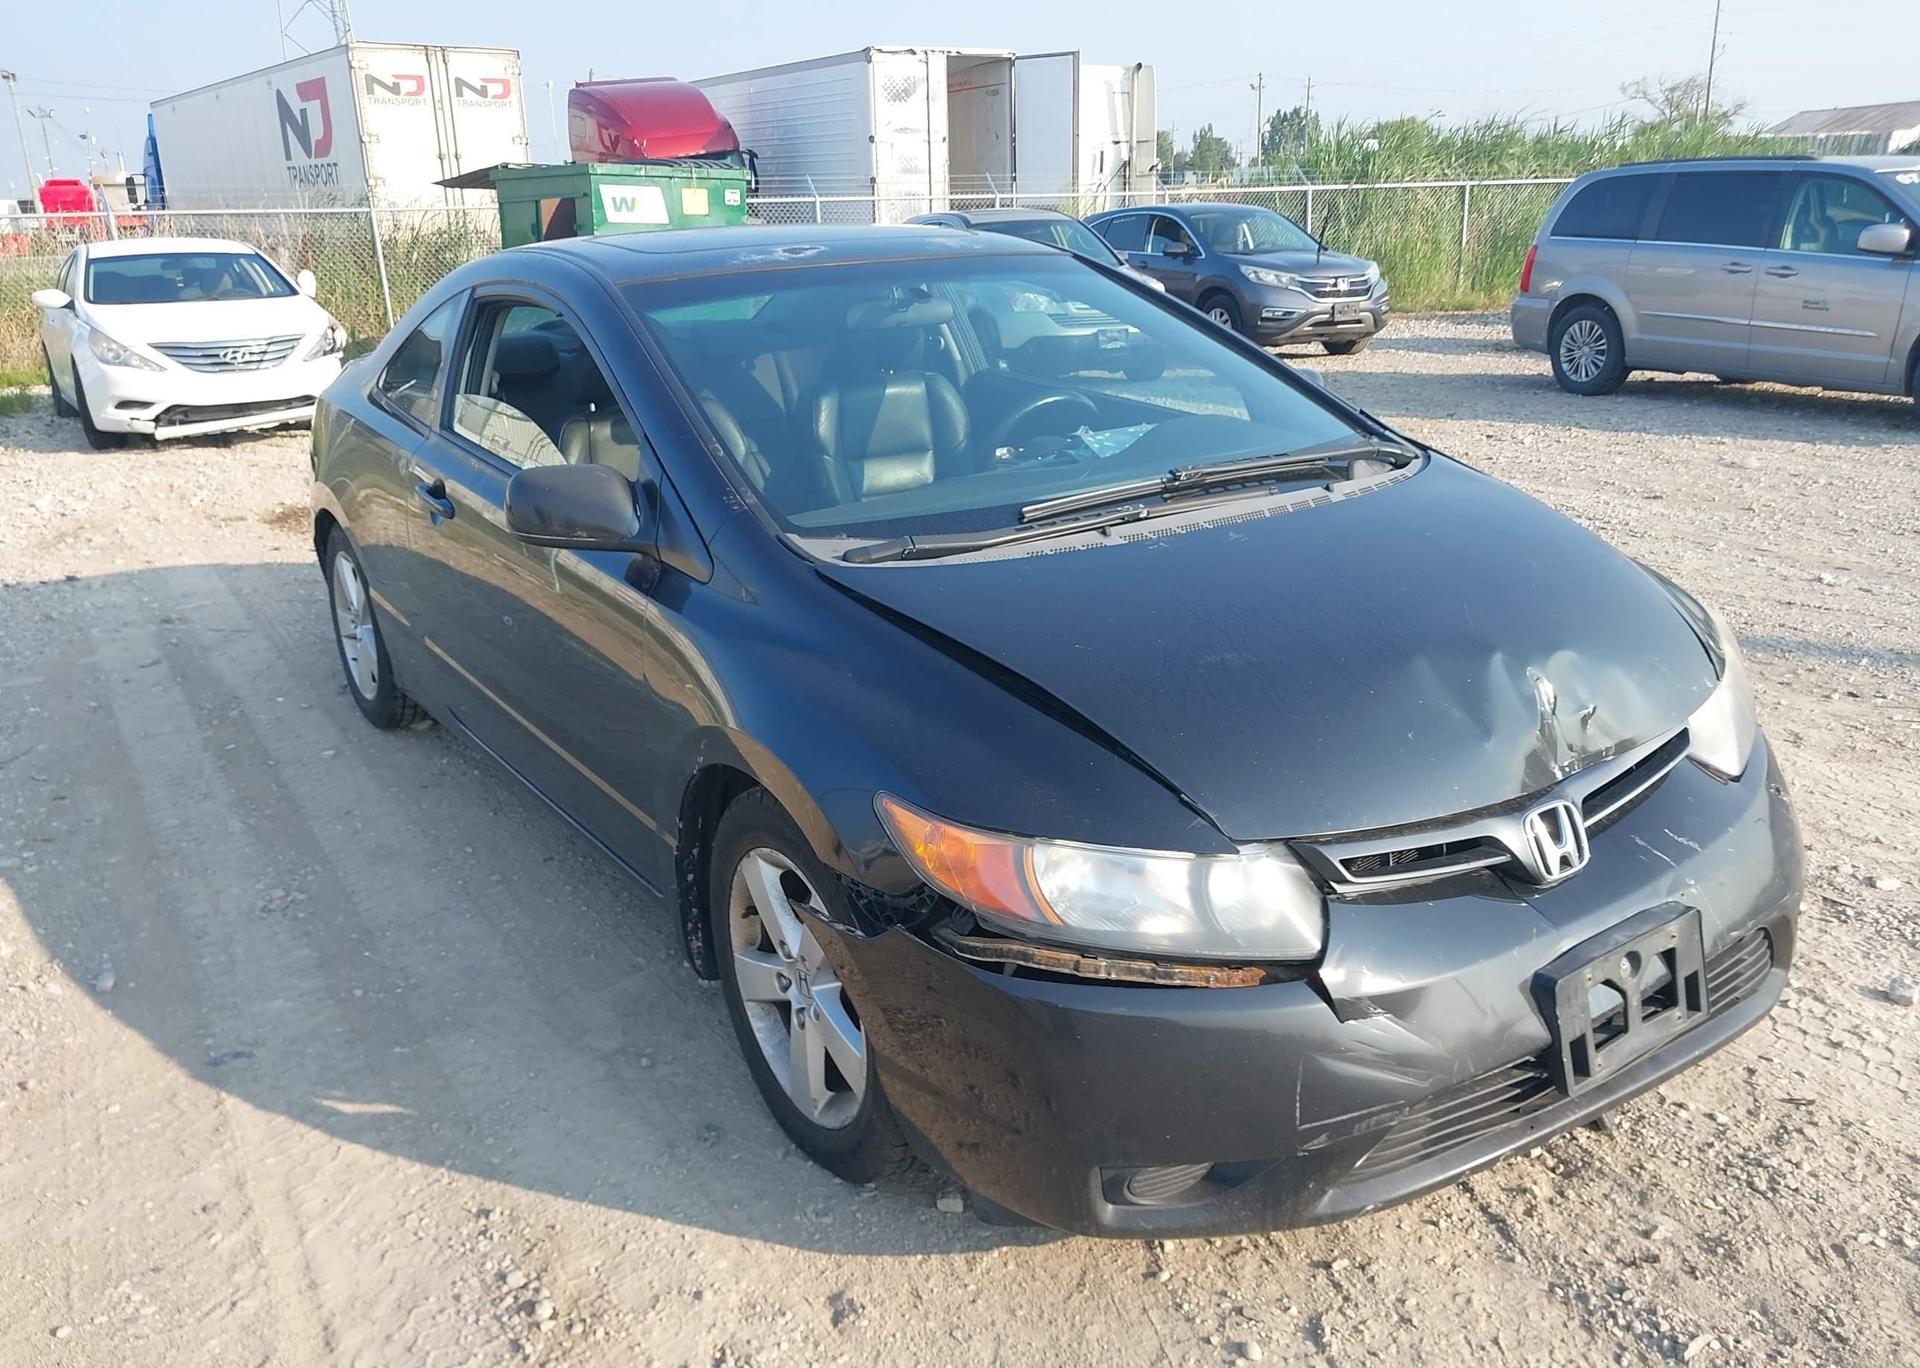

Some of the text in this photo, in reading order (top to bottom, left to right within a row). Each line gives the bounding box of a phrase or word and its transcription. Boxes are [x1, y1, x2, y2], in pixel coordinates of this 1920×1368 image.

[364, 73, 425, 97] NJ
[454, 76, 511, 99] NJ
[367, 97, 427, 107] TRANSPORT
[457, 99, 513, 109] TRANSPORT
[276, 76, 333, 161] NJ
[286, 162, 340, 188] TRANSPORT
